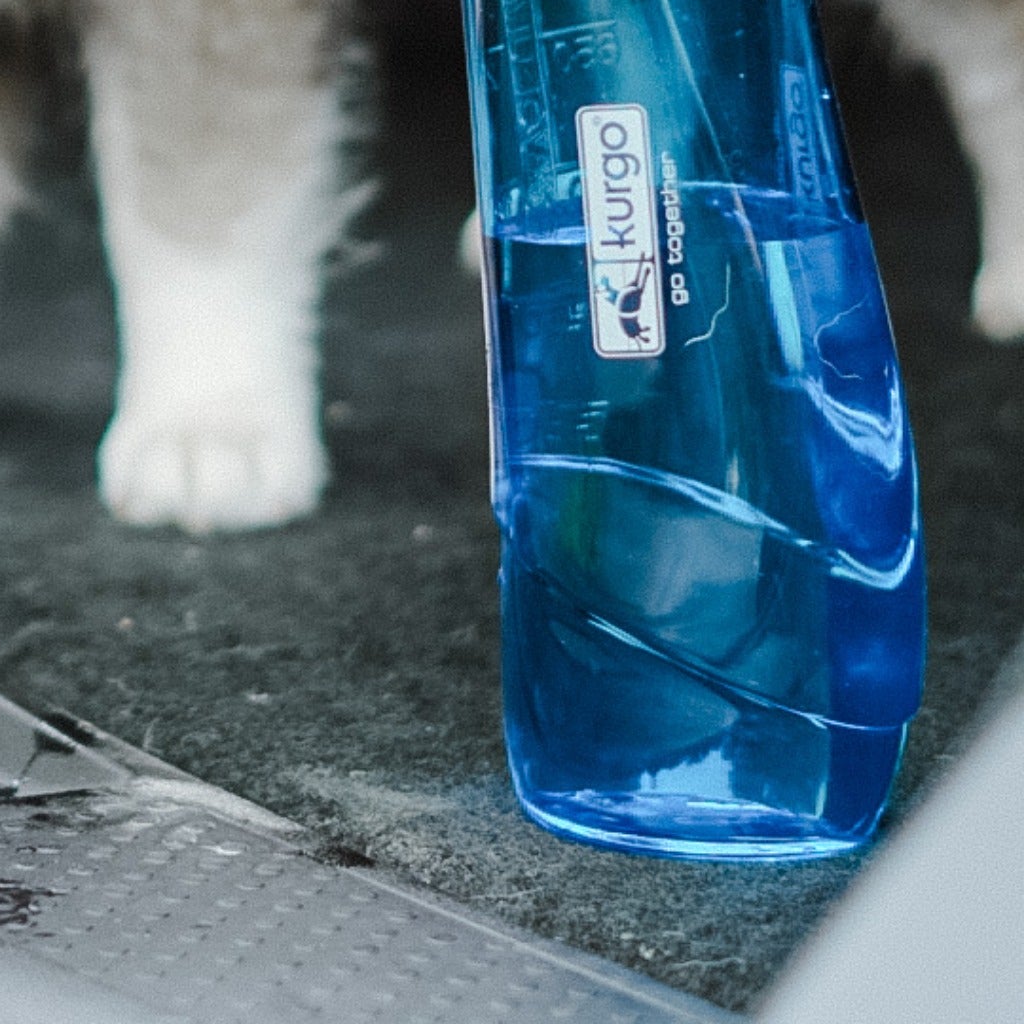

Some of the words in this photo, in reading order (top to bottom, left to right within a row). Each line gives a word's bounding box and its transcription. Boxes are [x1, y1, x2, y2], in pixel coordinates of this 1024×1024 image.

[599, 121, 641, 249] kurgo
[661, 151, 685, 264] together
[670, 273, 689, 306] go
